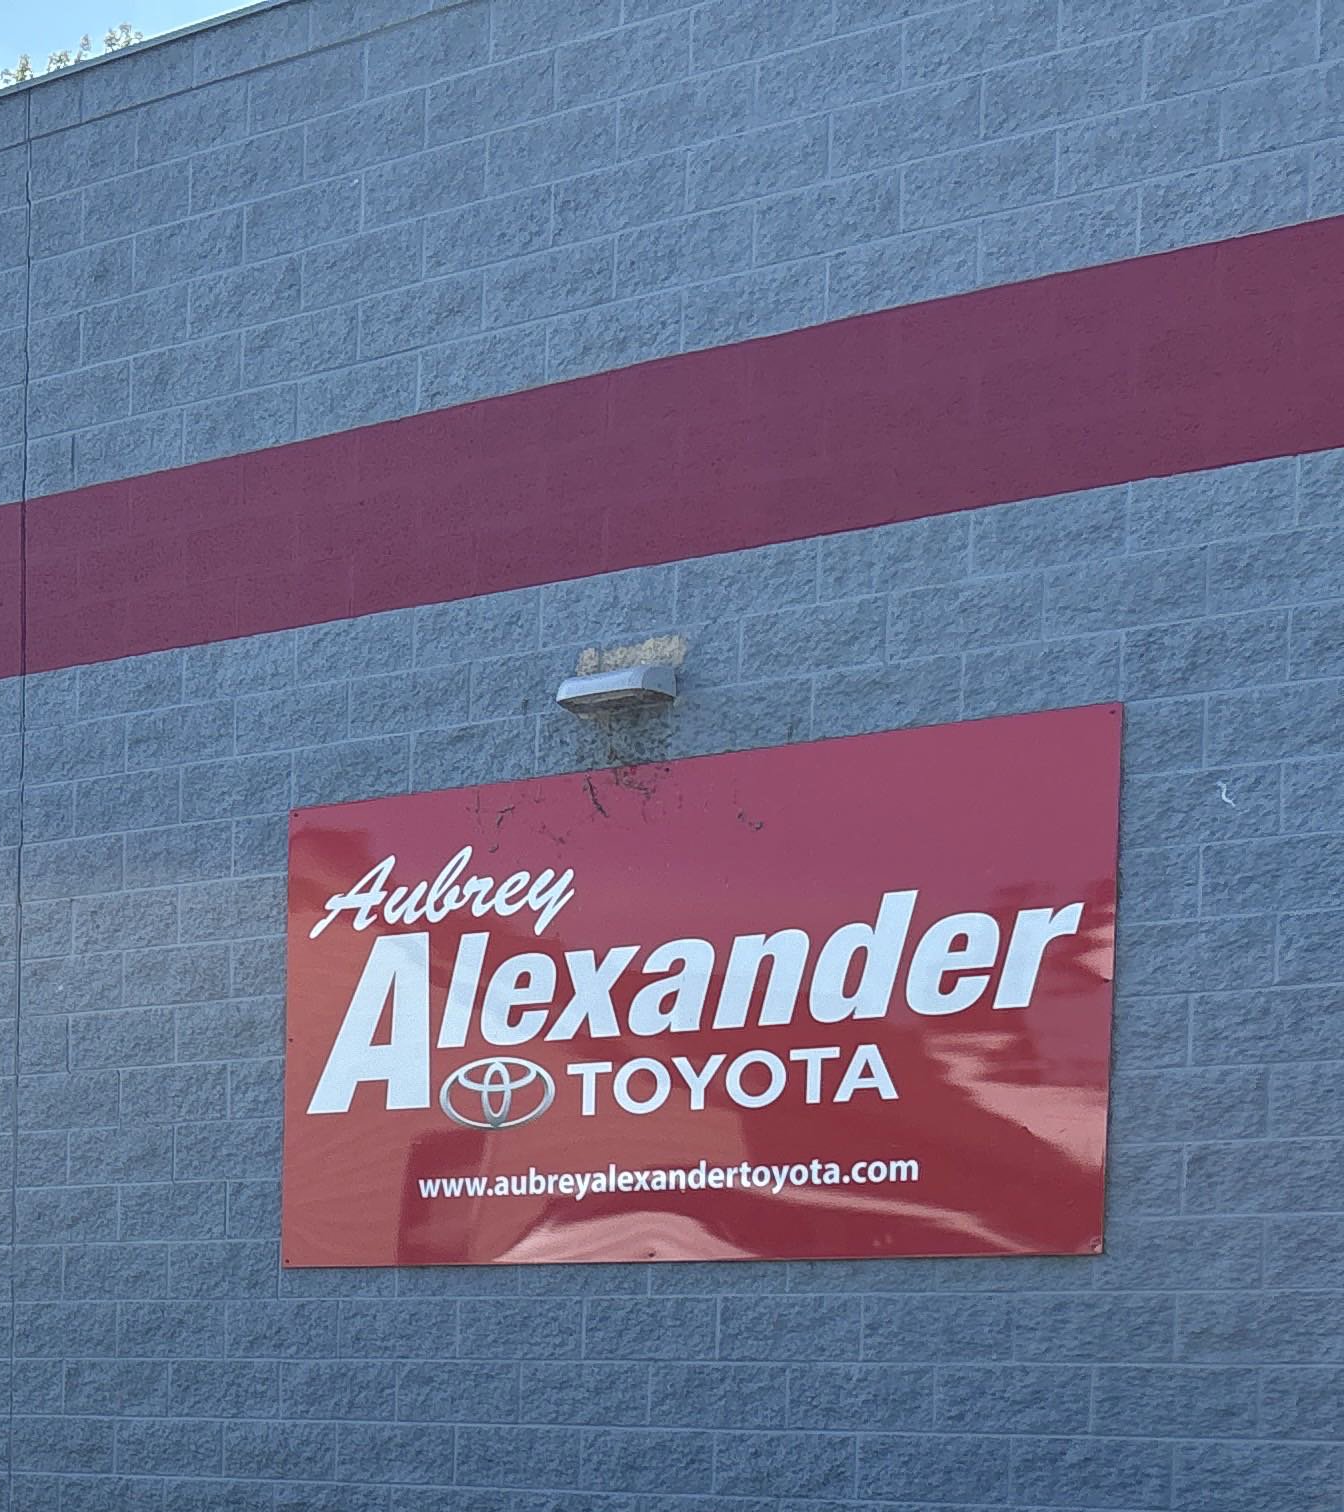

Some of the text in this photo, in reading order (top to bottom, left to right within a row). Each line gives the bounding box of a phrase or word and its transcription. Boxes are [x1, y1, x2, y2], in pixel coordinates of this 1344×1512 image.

[308, 845, 575, 939] Aubrey
[306, 889, 1085, 1115] Alexander
[566, 1043, 899, 1116] TOYOTA
[417, 1157, 919, 1201] www.aubreyalexandertoyota.com
